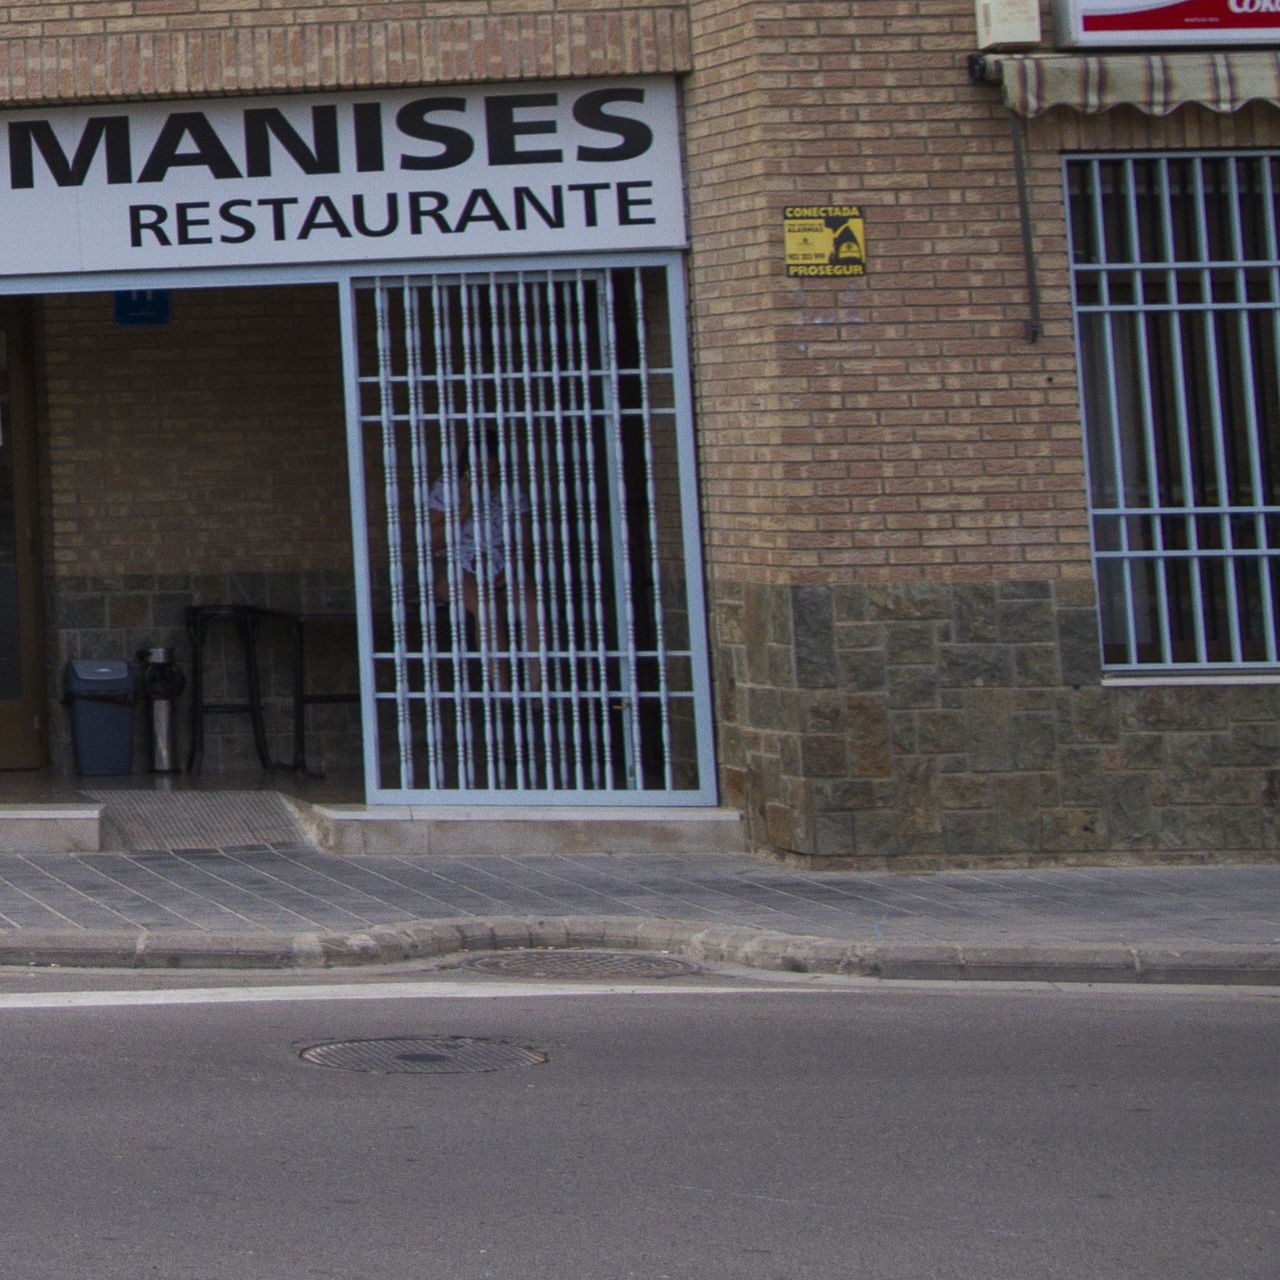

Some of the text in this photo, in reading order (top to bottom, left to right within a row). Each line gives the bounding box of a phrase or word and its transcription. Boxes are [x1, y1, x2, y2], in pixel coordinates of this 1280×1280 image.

[7, 87, 654, 190] MANISES
[129, 181, 656, 248] RESTAURANTE
[785, 207, 860, 217] CONECTADA
[789, 265, 863, 276] PROSEGUR
